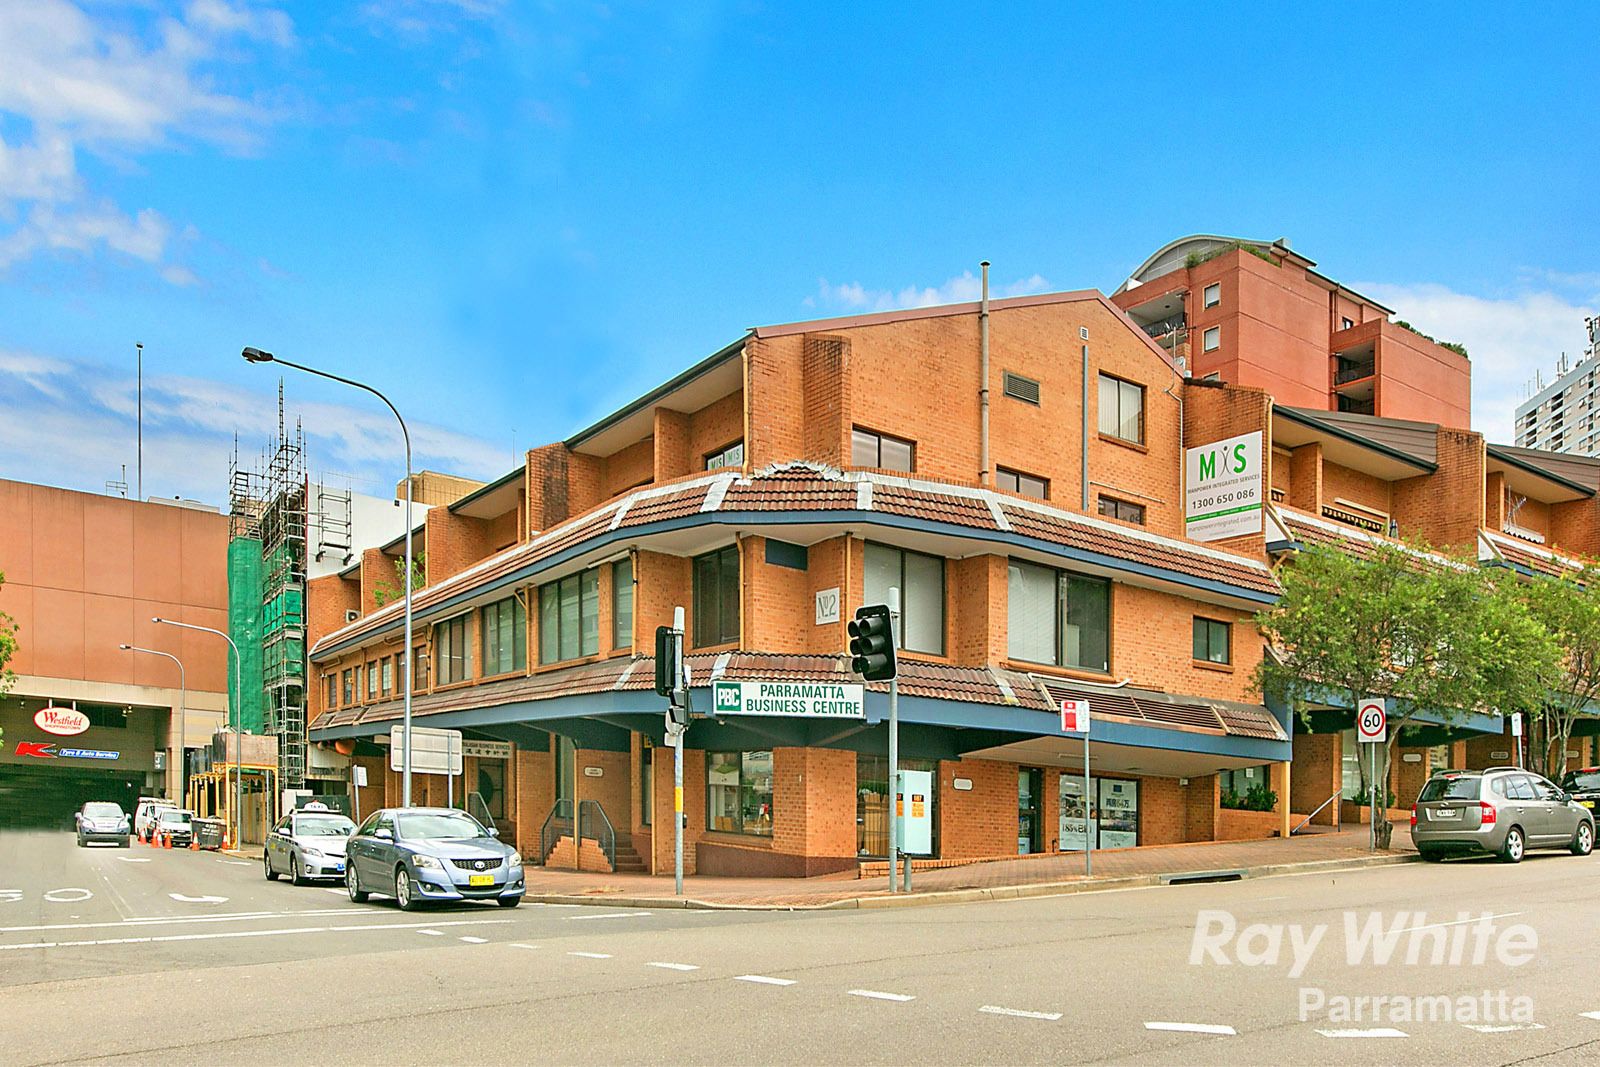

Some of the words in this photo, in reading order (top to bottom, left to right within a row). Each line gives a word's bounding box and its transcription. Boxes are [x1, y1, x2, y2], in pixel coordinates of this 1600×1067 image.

[1188, 485, 1212, 494] MANPOWER
[1212, 479, 1239, 489] INTEGRATED
[1239, 473, 1260, 483] SERVICES
[1192, 497, 1214, 509] 1300
[1216, 493, 1234, 505] 650
[1236, 488, 1255, 500] 086
[717, 687, 740, 706] PBC
[760, 684, 845, 699] PARRAMATTA
[746, 699, 806, 713] BUSINESS
[813, 700, 860, 715] CENTRE
[44, 711, 82, 726] Westfield
[1363, 713, 1381, 728] 60
